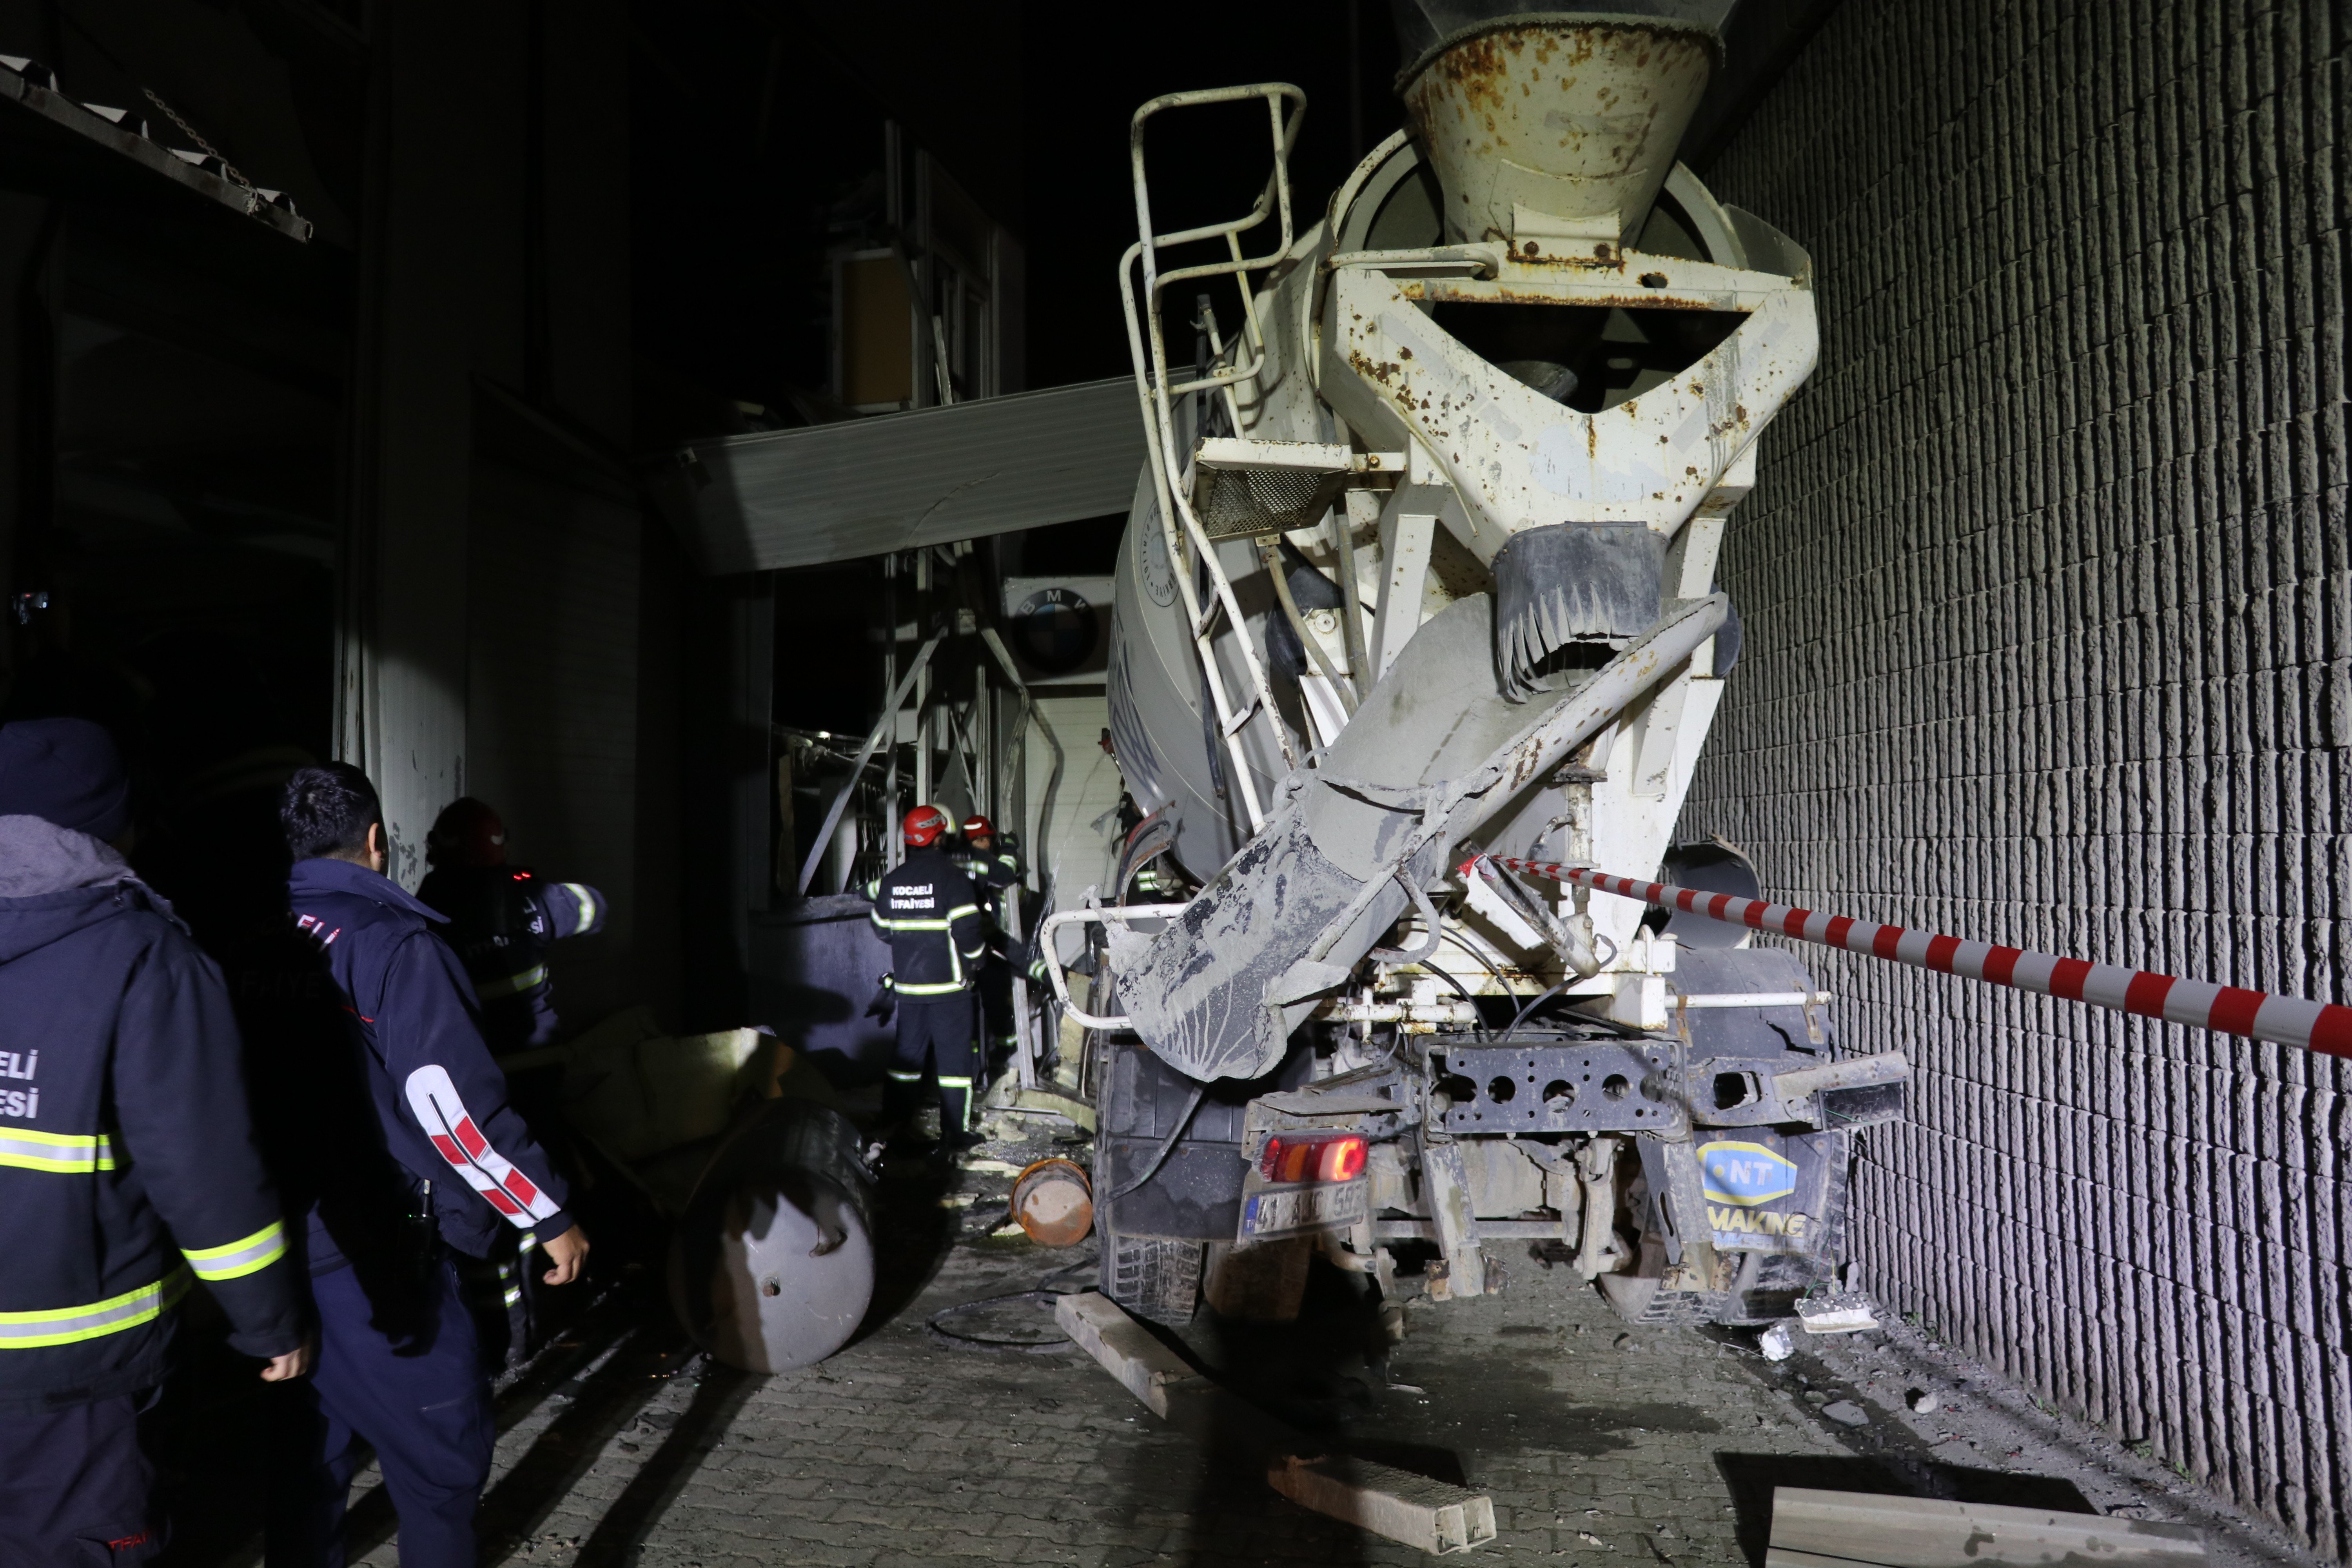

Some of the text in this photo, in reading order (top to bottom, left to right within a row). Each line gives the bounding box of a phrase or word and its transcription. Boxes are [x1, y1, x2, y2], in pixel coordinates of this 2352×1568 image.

[1156, 572, 1176, 599] ÜRKİYE
[1020, 589, 1089, 615] BMW
[892, 883, 933, 896] KOCAELİ
[891, 897, 935, 909] İTFAİYESİ
[1730, 1159, 1773, 1185] NT
[1256, 1197, 1278, 1230] 41
